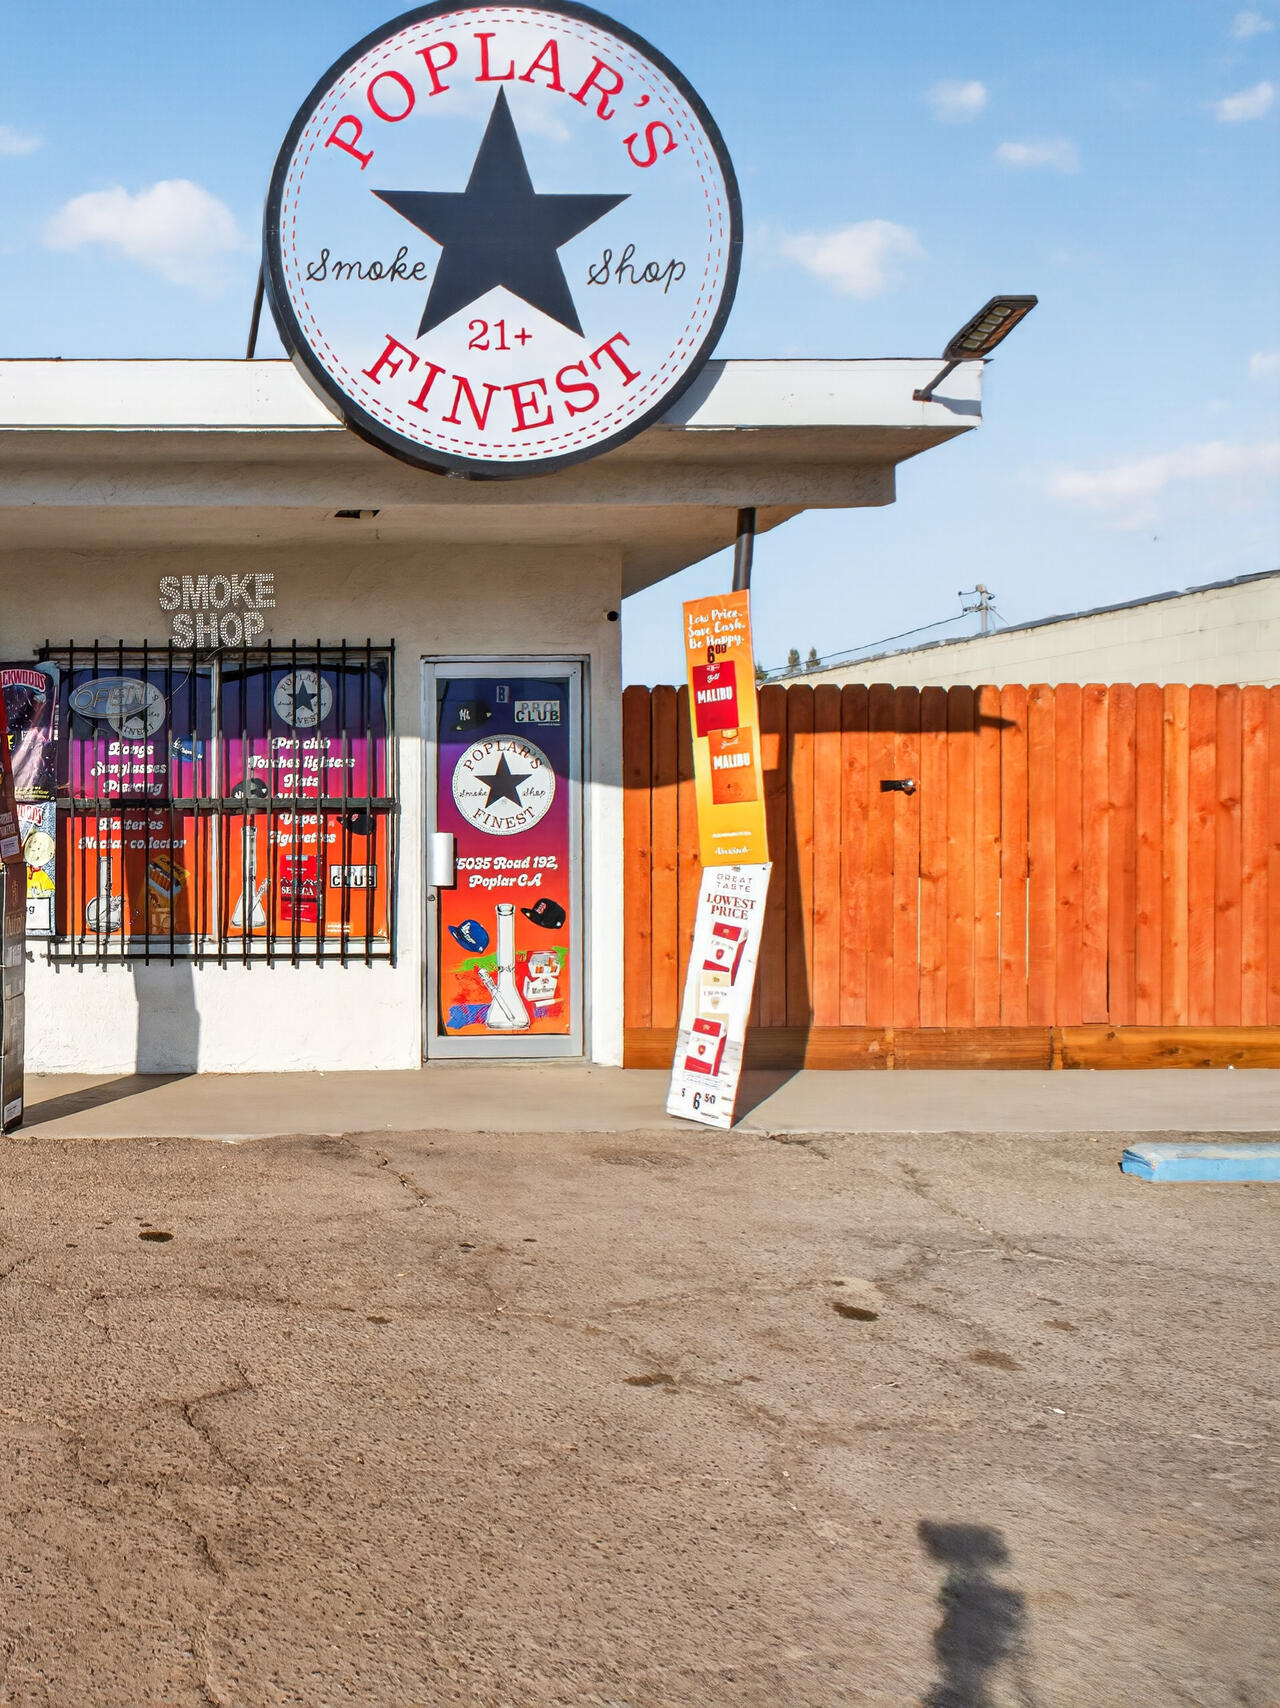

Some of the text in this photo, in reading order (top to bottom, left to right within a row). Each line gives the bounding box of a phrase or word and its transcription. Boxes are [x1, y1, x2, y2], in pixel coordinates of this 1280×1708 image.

[325, 32, 678, 170] POPLAR'S
[306, 246, 427, 281] Smoke
[587, 243, 686, 293] Shop
[468, 319, 533, 351] 21+
[362, 332, 641, 432] FINEST
[159, 573, 276, 610] SMOKE
[688, 609, 743, 625] Low Price.
[172, 612, 265, 648] SHOP
[688, 618, 746, 638] Save Cash.
[689, 638, 702, 649] Be
[1, 669, 46, 692] CKWOODS
[498, 687, 505, 701] B
[697, 686, 733, 704] MALIBU
[516, 711, 559, 722] CLUB
[463, 740, 543, 772] POPLAR'S
[713, 752, 751, 770] MALIBU
[472, 806, 537, 829] FINEST
[456, 855, 559, 870] 5035 Road 192,
[469, 873, 542, 890] Poplar CA
[716, 873, 752, 884] GREAT
[716, 881, 751, 893] TASTE
[706, 893, 757, 910] LOWEST
[711, 905, 749, 920] PRICE
